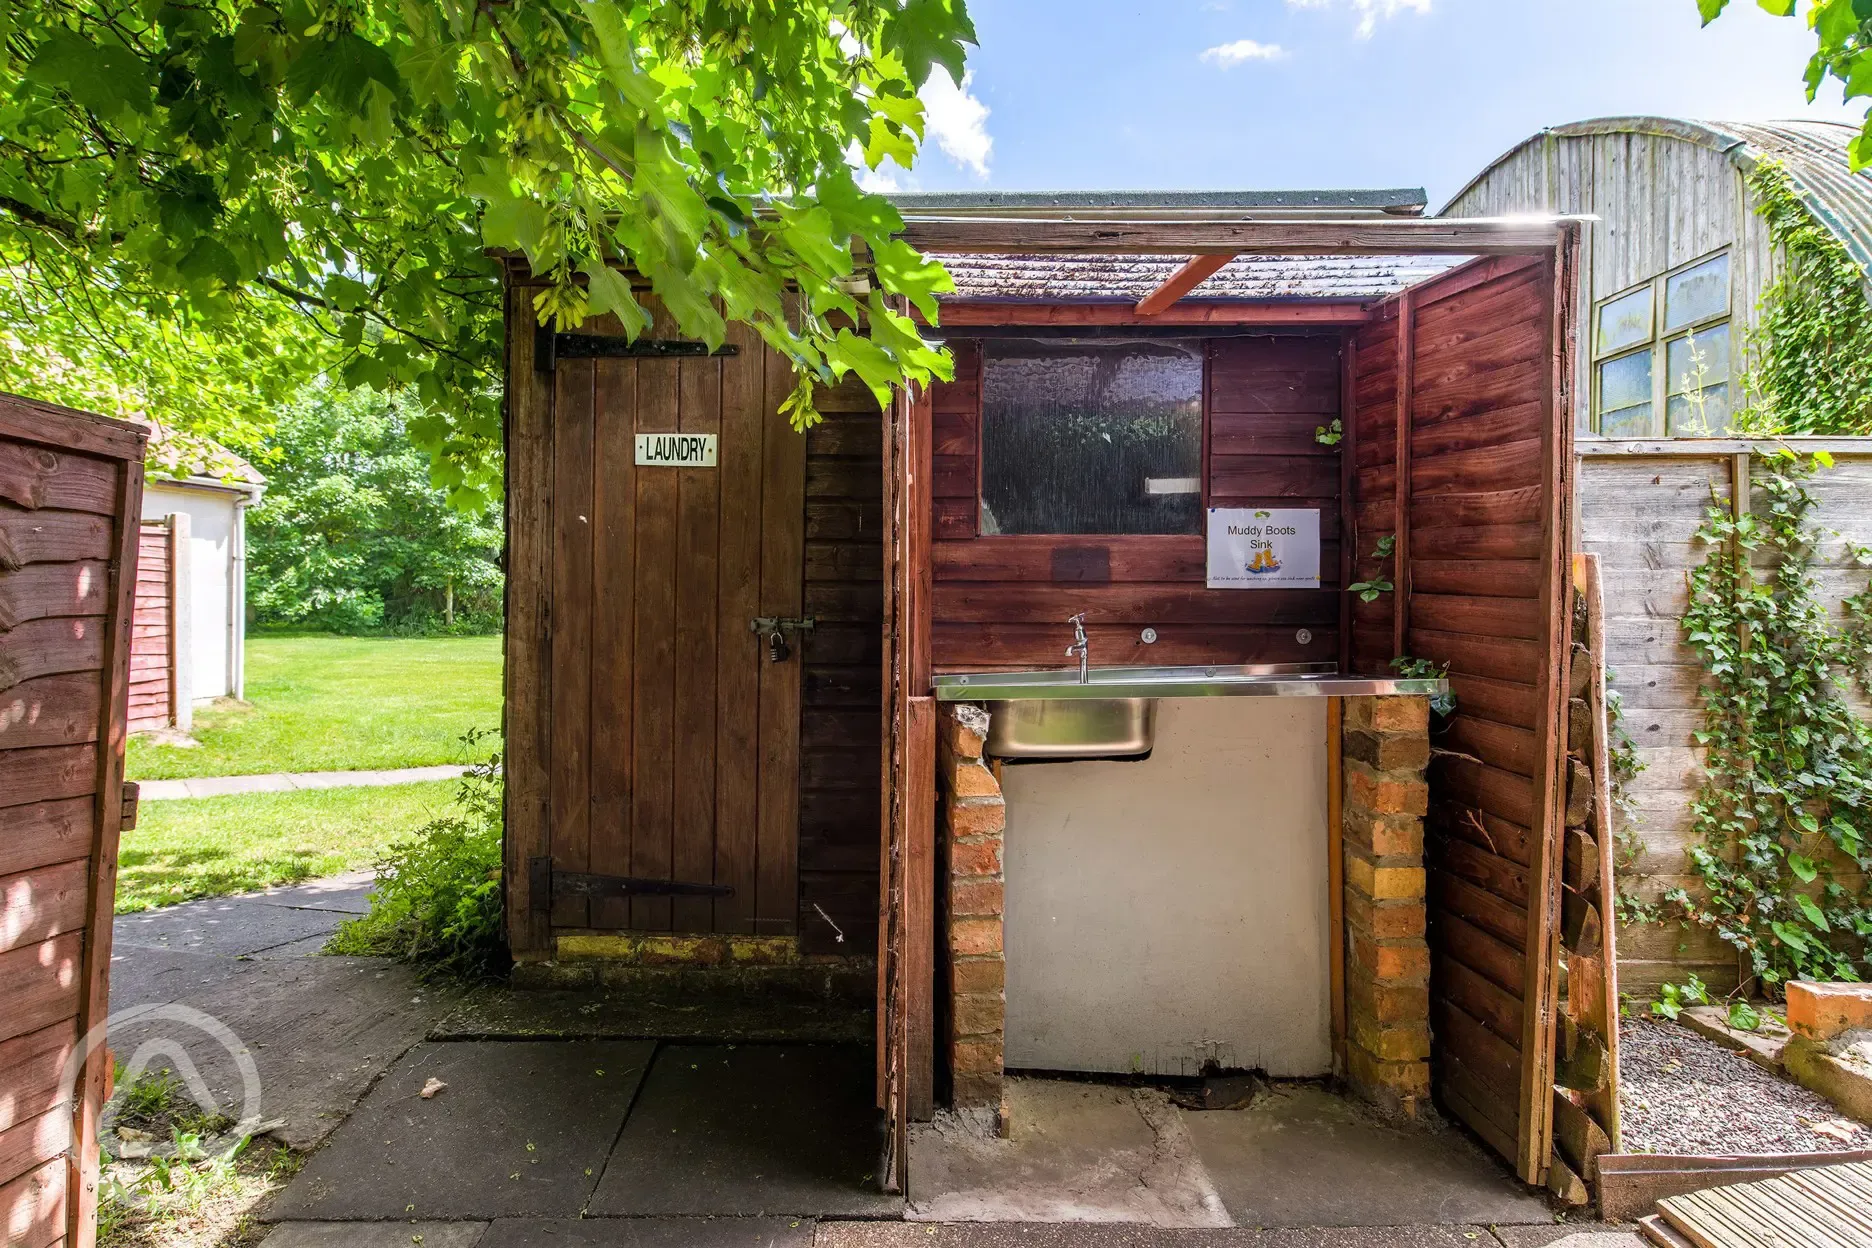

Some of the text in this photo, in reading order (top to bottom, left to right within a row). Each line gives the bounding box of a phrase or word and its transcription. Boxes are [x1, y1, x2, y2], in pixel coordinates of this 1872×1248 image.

[646, 436, 707, 461] LAUNDRY
[1227, 525, 1296, 537] Muddy Boots
[1250, 539, 1273, 549] Sink
